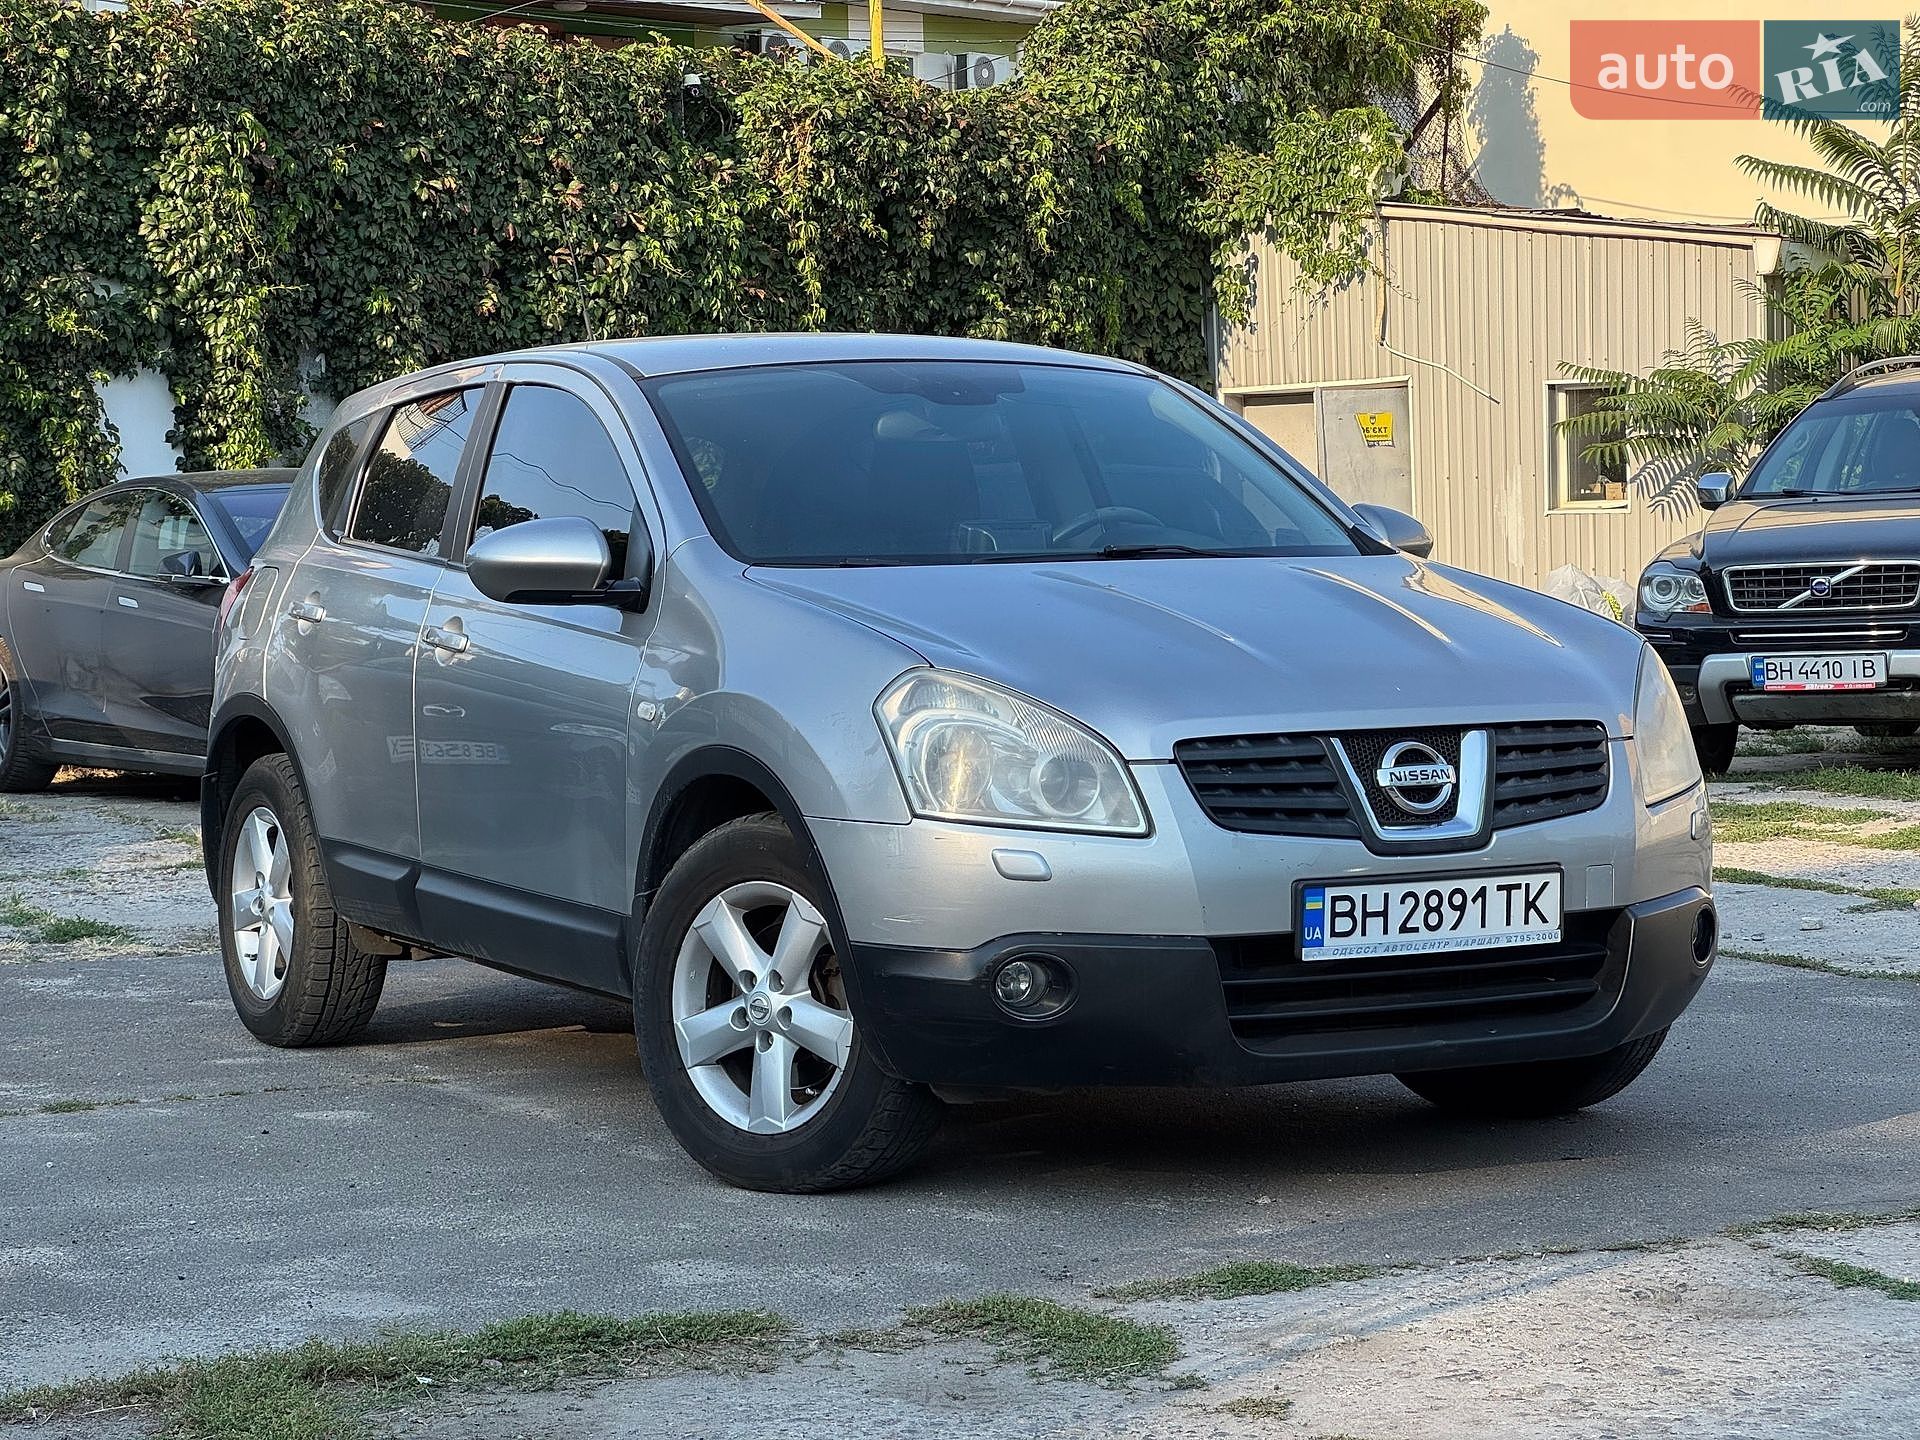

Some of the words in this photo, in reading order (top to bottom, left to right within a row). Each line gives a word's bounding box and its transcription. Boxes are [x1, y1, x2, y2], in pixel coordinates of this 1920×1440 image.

[1765, 661, 1793, 681] BH
[1798, 660, 1843, 680] 4410
[1852, 659, 1876, 679] IB
[1389, 768, 1451, 783] NISSAN
[1329, 892, 1390, 939] BH
[1398, 885, 1487, 935] 2891
[1496, 881, 1551, 927] TK
[1304, 926, 1322, 941] UA
[1332, 946, 1378, 956] ОДЕССА
[1383, 940, 1450, 953] АВТОЦЕНТР
[1454, 937, 1500, 948] МАРШАЛ
